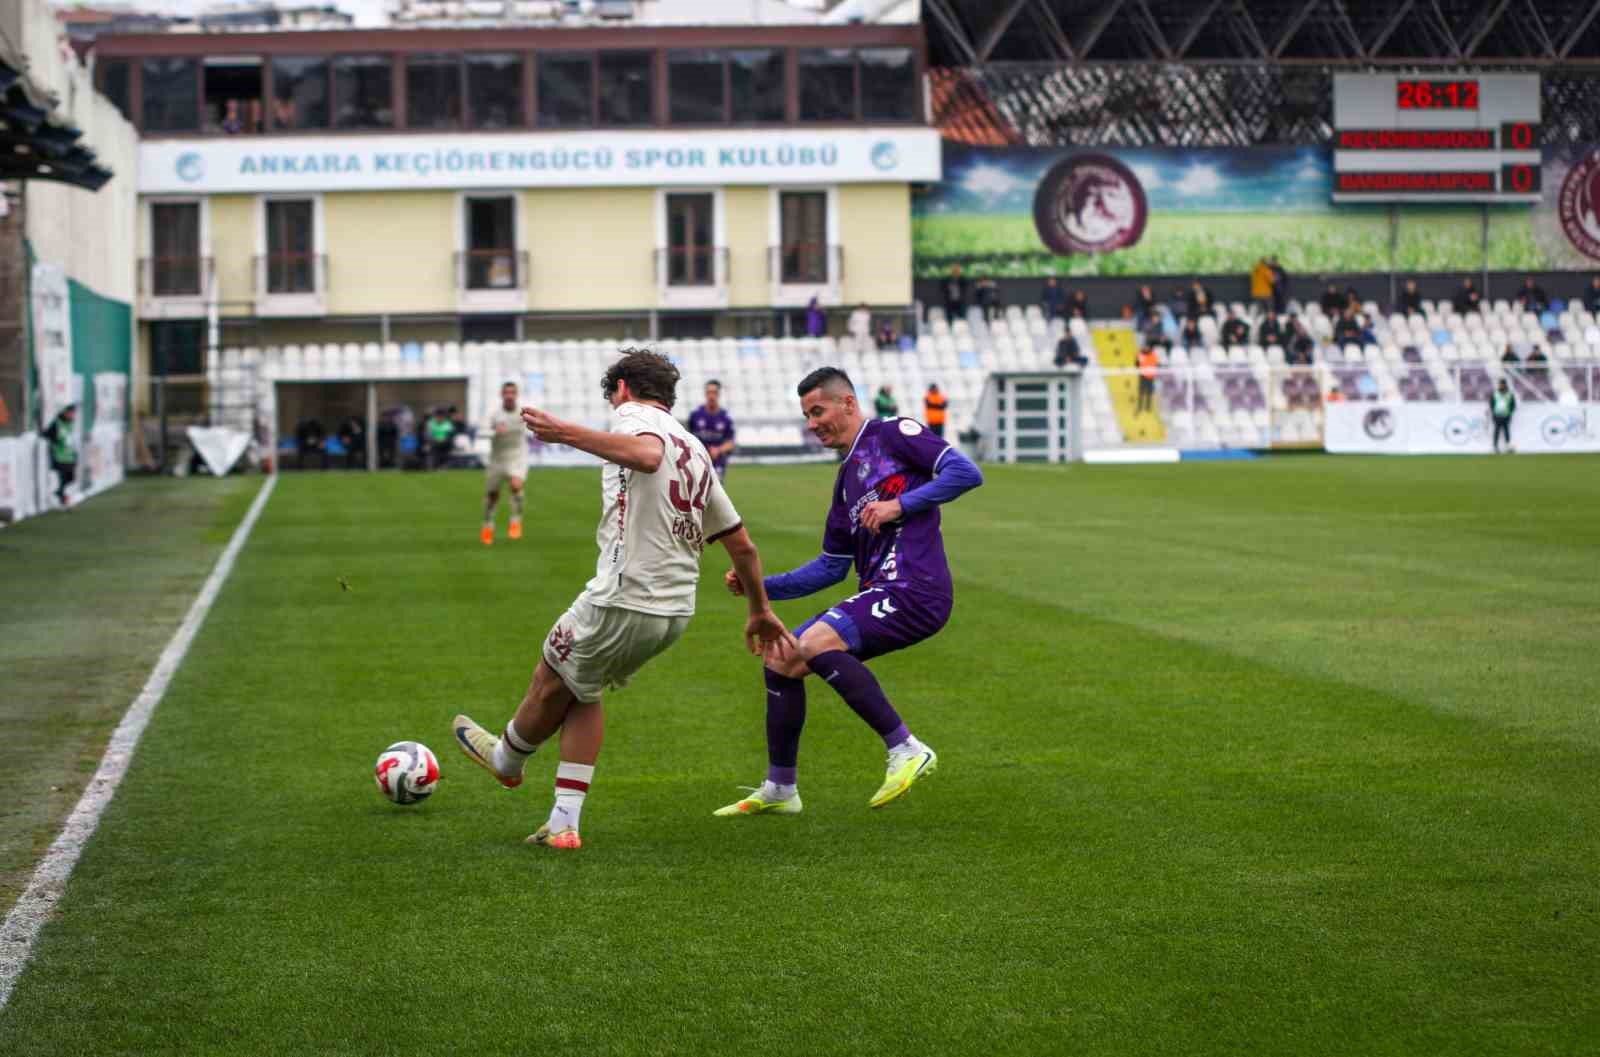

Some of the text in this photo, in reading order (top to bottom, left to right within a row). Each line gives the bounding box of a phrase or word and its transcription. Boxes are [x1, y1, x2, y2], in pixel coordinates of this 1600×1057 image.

[1397, 80, 1479, 109] 26:12
[1511, 122, 1532, 149] 0
[238, 143, 839, 175] ANKARA KEÇİÖRENGÜCÜ SPOR KULÜBÜ
[1511, 164, 1533, 193] 0
